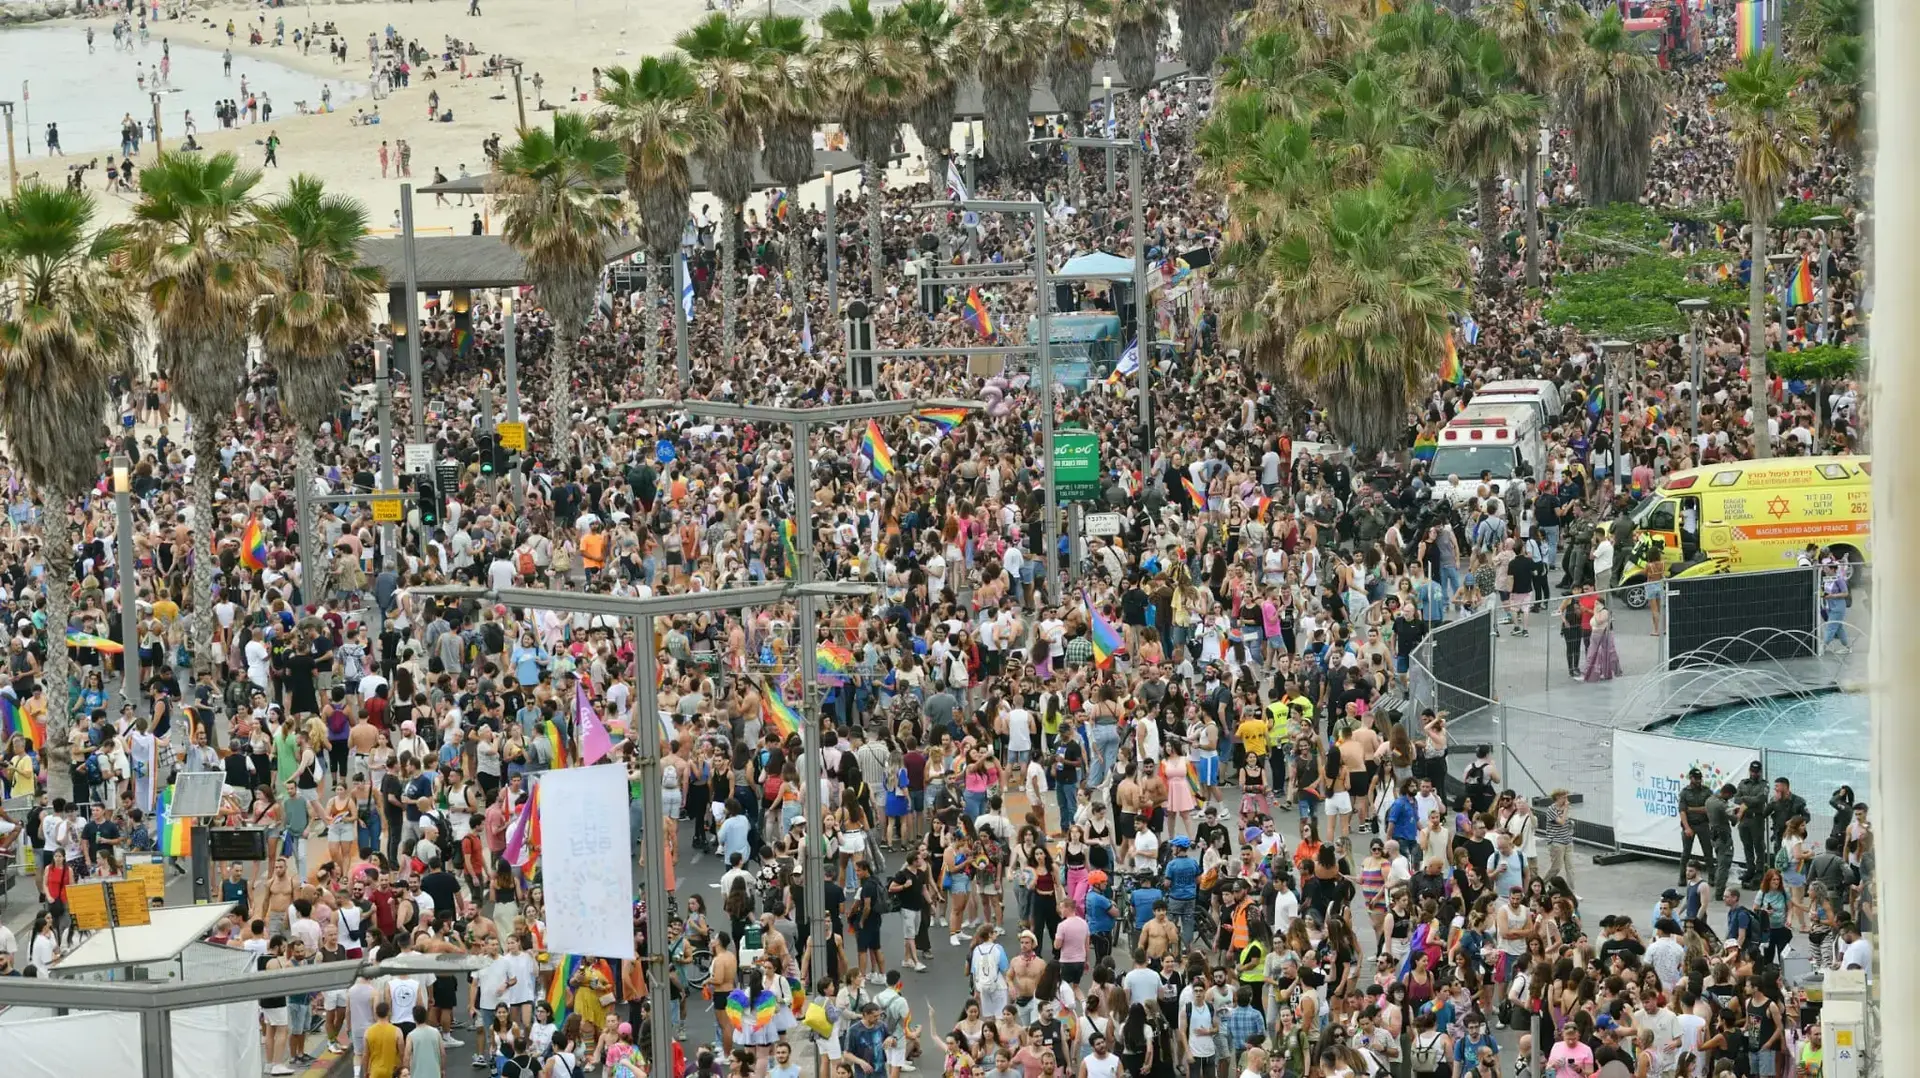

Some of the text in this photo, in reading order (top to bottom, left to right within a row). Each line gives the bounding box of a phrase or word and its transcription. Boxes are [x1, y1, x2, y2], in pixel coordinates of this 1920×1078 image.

[1851, 503, 1868, 513] 262
[1650, 776, 1680, 791] TEL תל
[1636, 787, 1679, 804] AVIV אביב
[1644, 801, 1677, 817] YAFO פו
